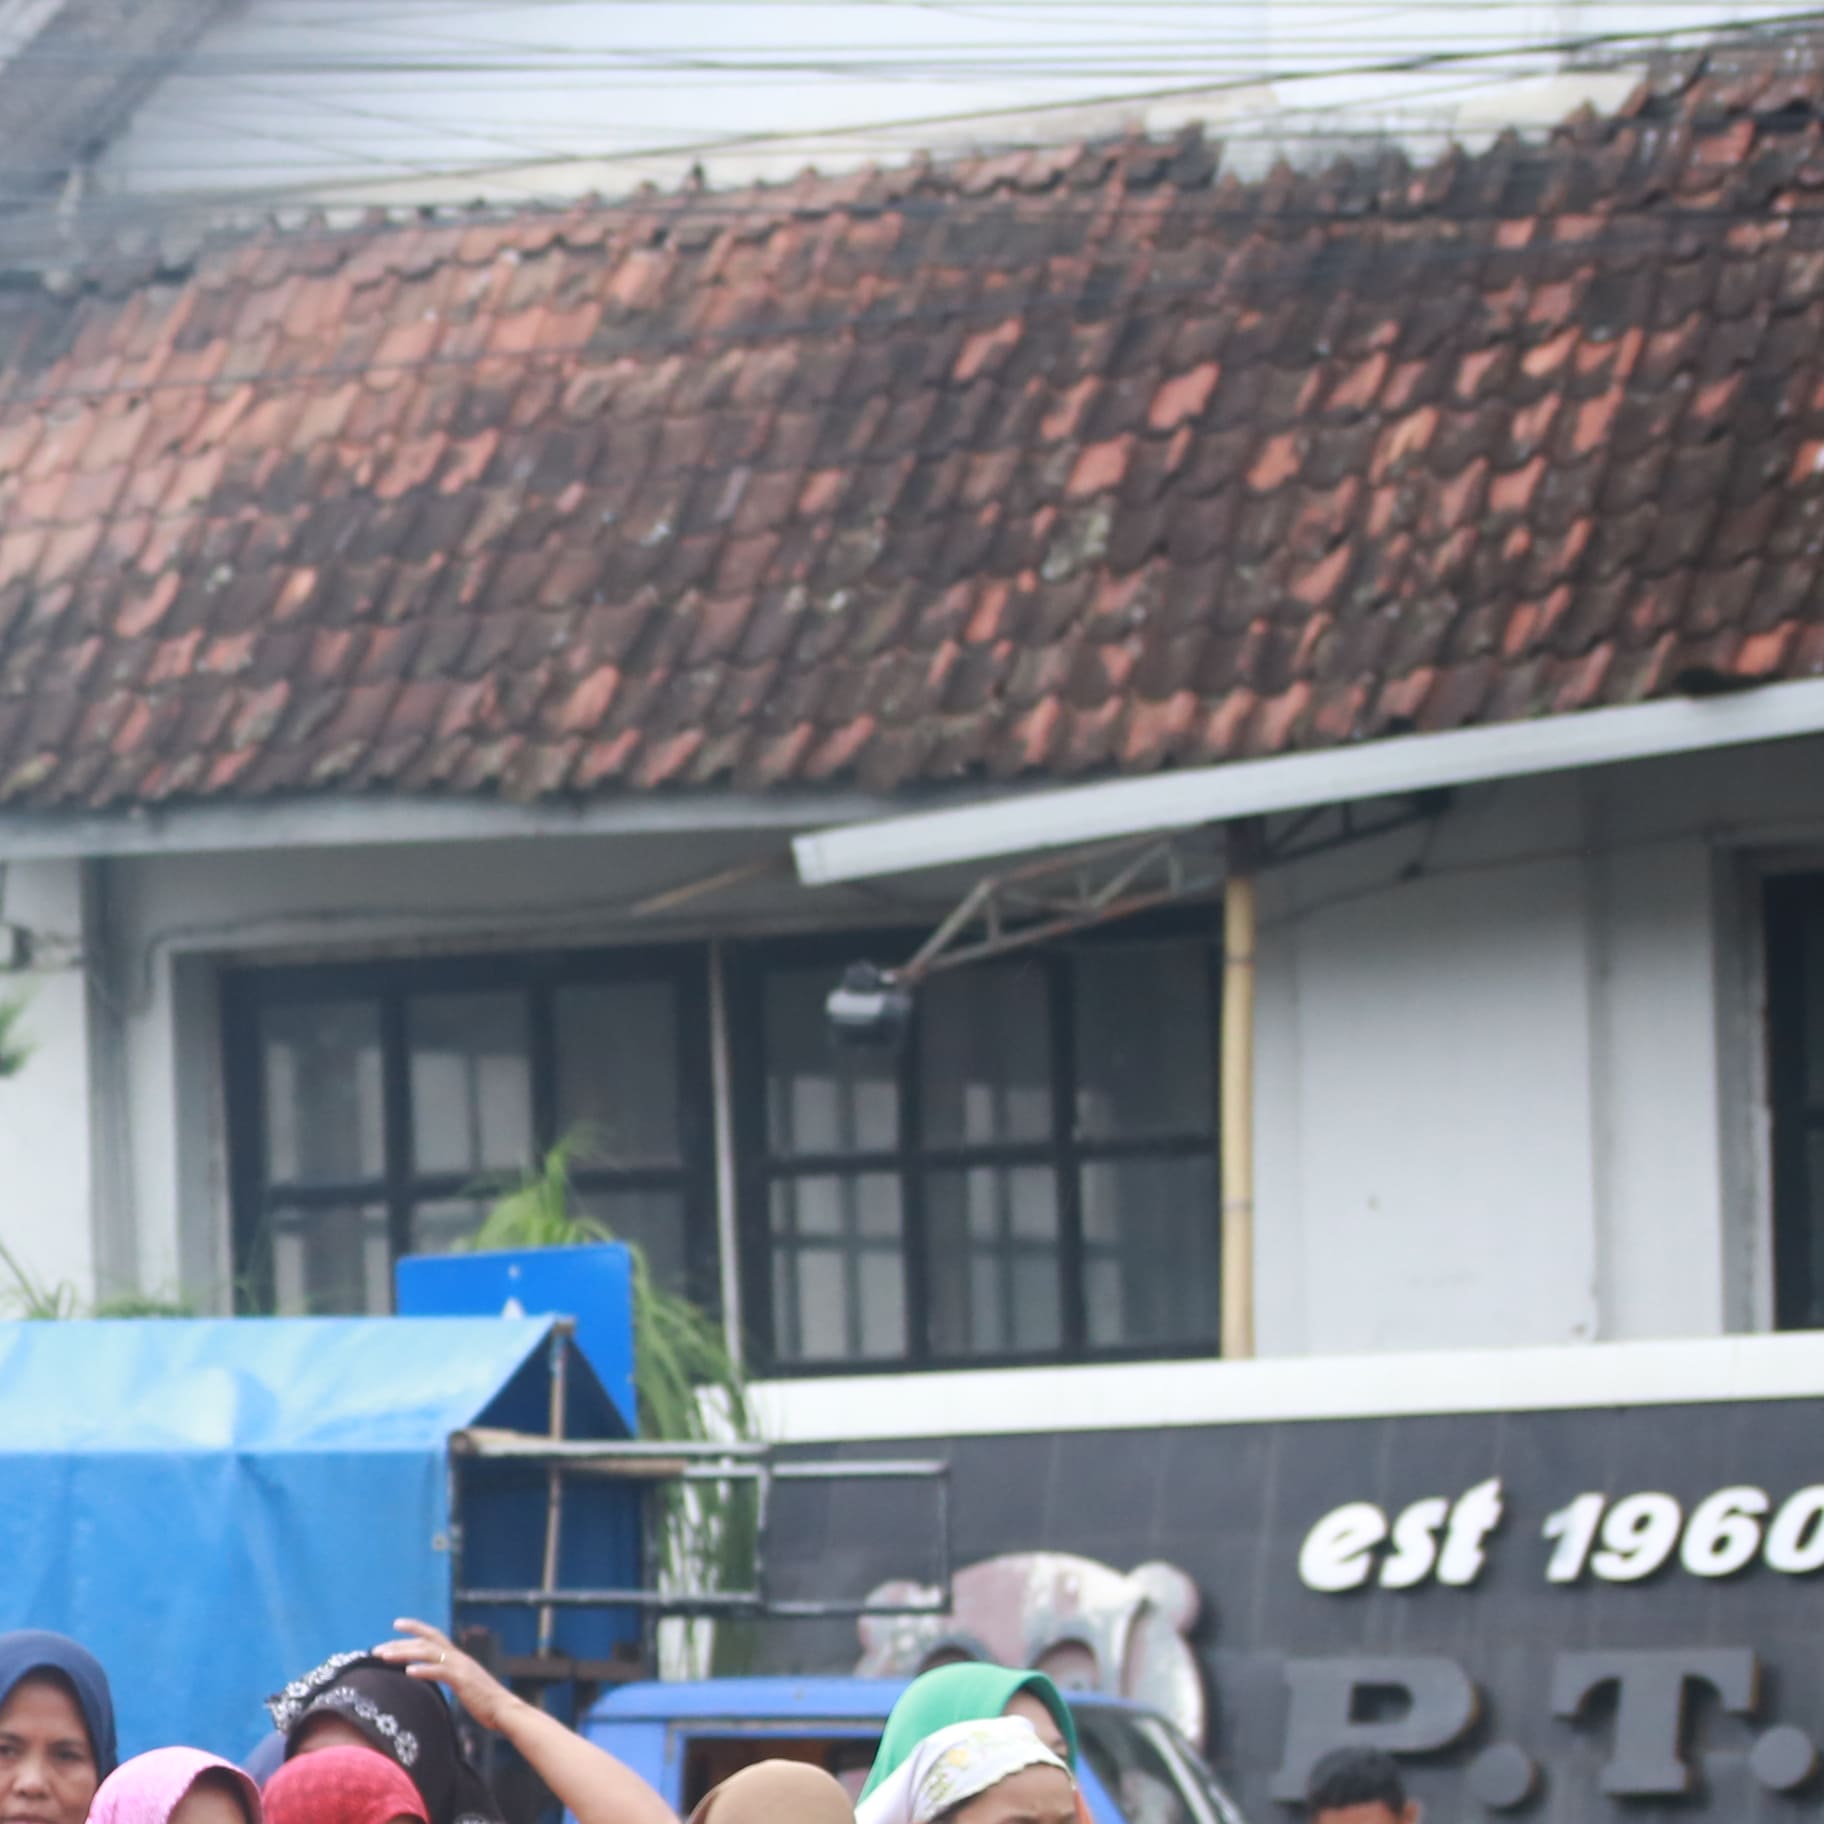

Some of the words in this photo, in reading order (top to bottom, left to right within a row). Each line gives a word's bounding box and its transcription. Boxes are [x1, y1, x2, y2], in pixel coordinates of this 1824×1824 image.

[1297, 1478, 1502, 1592] est
[1541, 1485, 1824, 1583] 1960
[1271, 1648, 1817, 1809] P.T.
